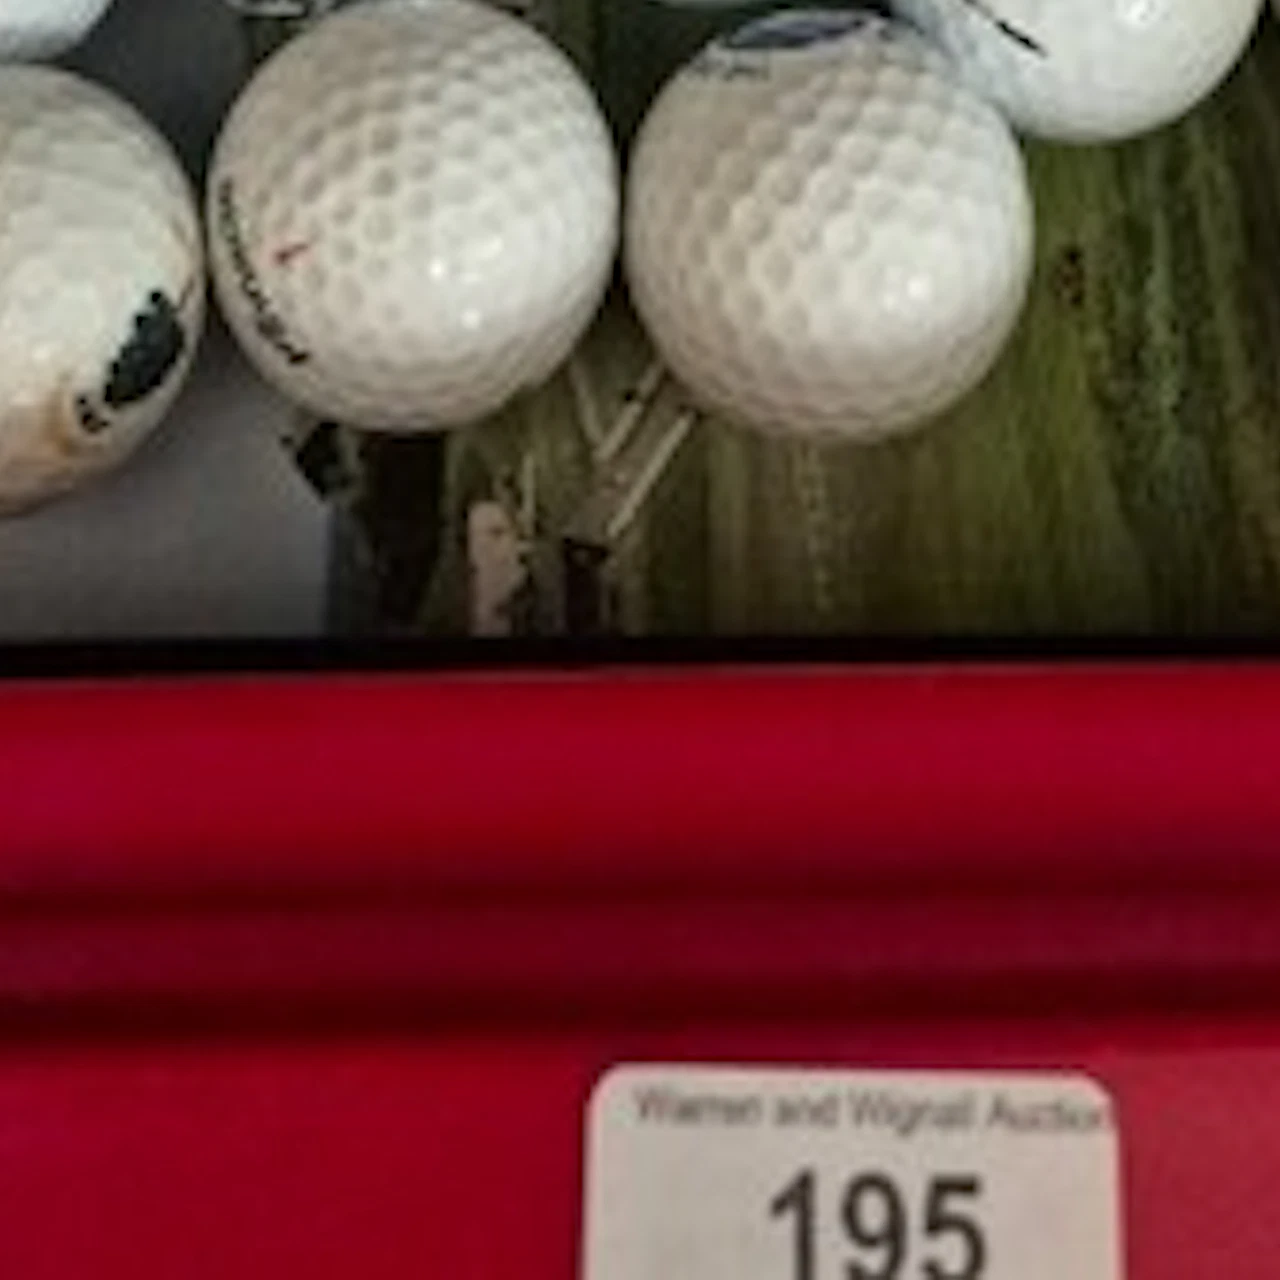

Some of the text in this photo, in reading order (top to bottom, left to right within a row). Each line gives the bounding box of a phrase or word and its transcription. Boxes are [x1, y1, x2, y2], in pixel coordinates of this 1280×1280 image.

[632, 1086, 762, 1127] Warren
[773, 1088, 840, 1127] and
[768, 1167, 986, 1280] 195
